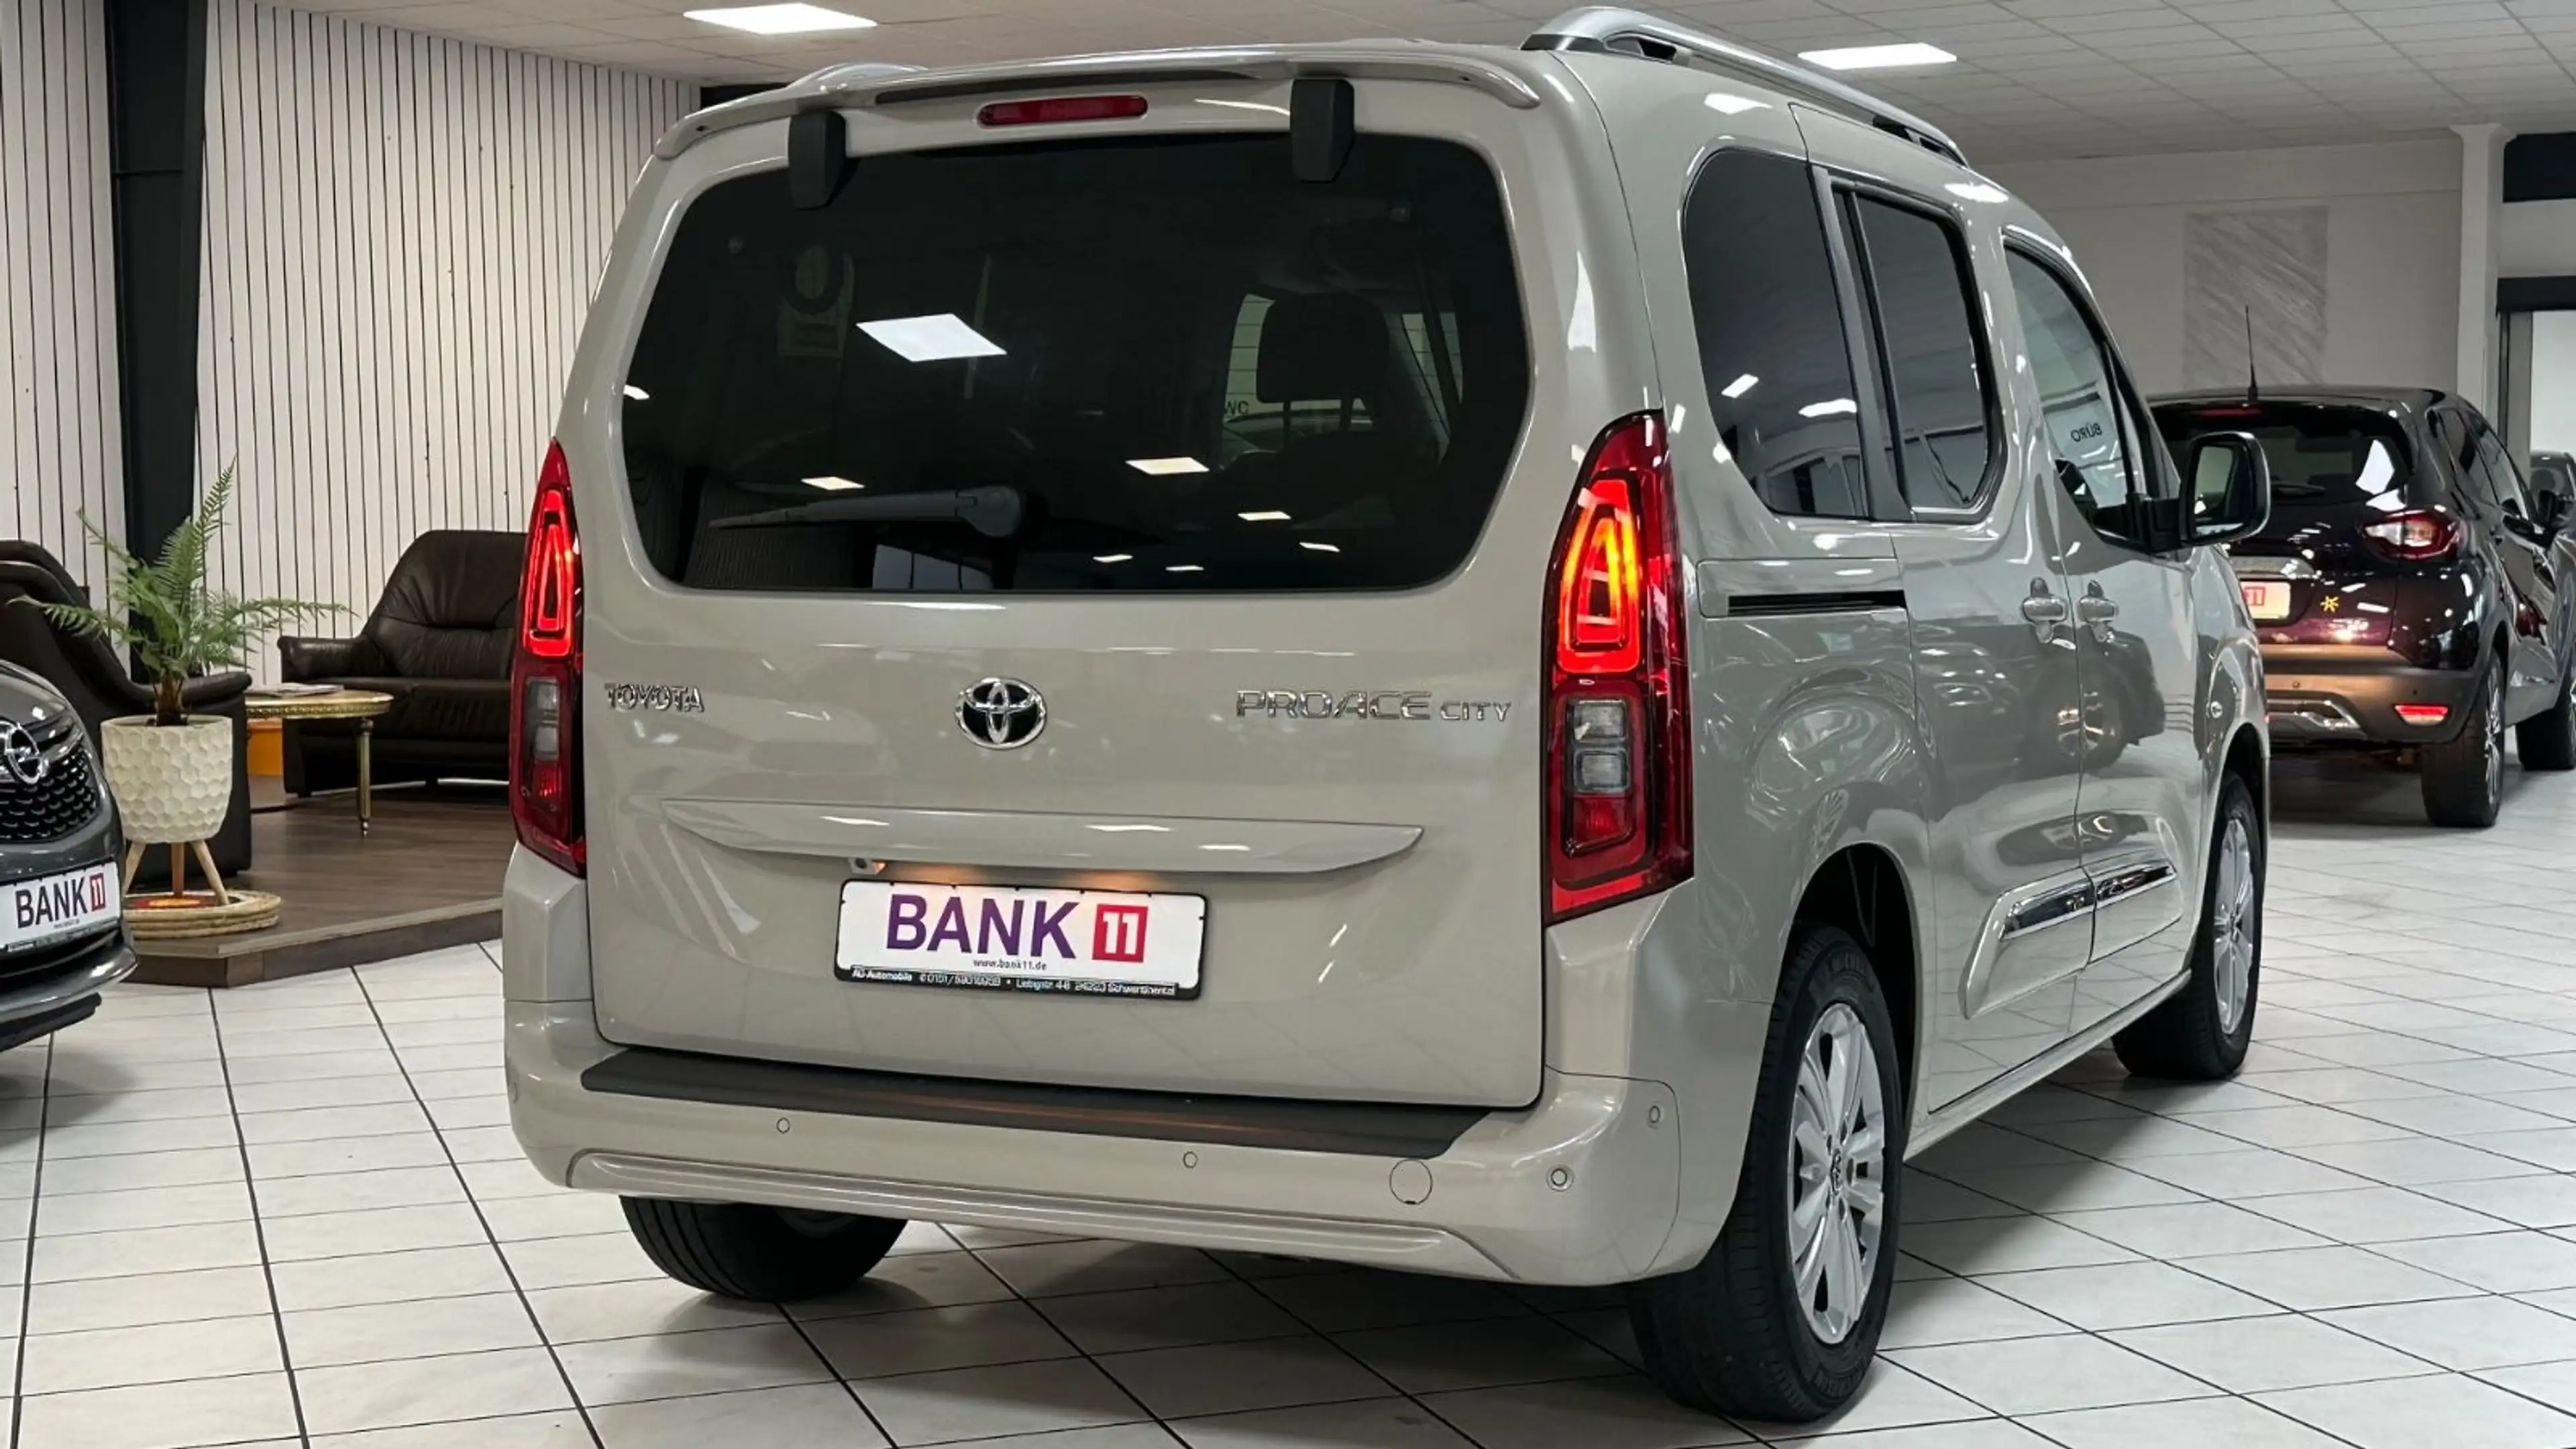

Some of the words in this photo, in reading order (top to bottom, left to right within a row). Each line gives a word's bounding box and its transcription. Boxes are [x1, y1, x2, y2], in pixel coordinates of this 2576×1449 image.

[604, 682, 704, 712] TOYOTA
[1236, 690, 1432, 720] PROACE
[1440, 702, 1511, 722] CITY
[15, 877, 87, 928] BANK
[91, 875, 105, 908] 11
[885, 893, 1079, 959] BANK
[1098, 908, 1142, 958] 11
